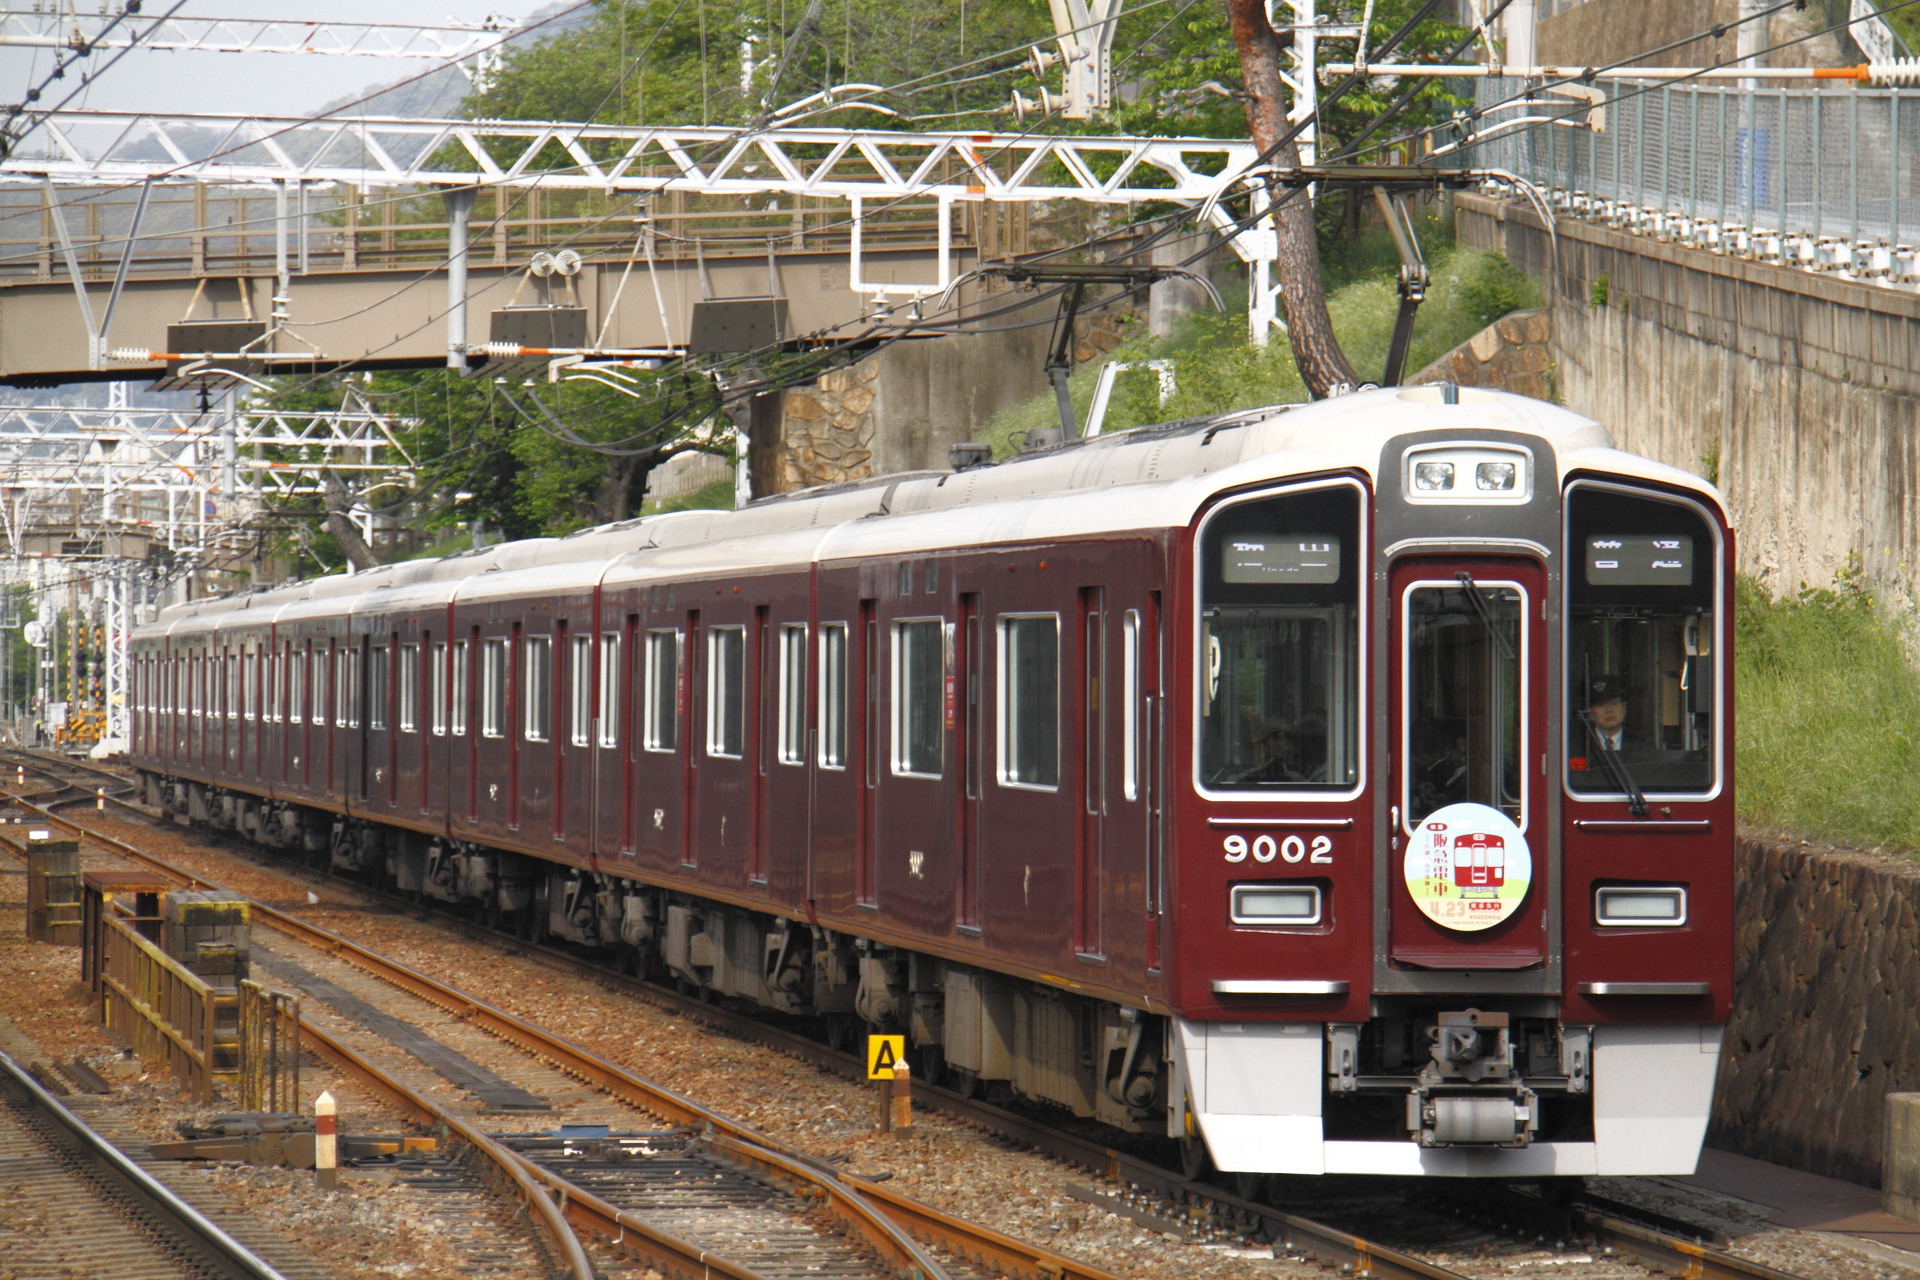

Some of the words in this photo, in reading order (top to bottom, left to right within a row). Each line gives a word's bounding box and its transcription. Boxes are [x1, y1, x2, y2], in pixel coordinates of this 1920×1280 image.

[1223, 834, 1333, 864] 9002
[1430, 901, 1466, 917] 4.23
[872, 1040, 897, 1075] A
